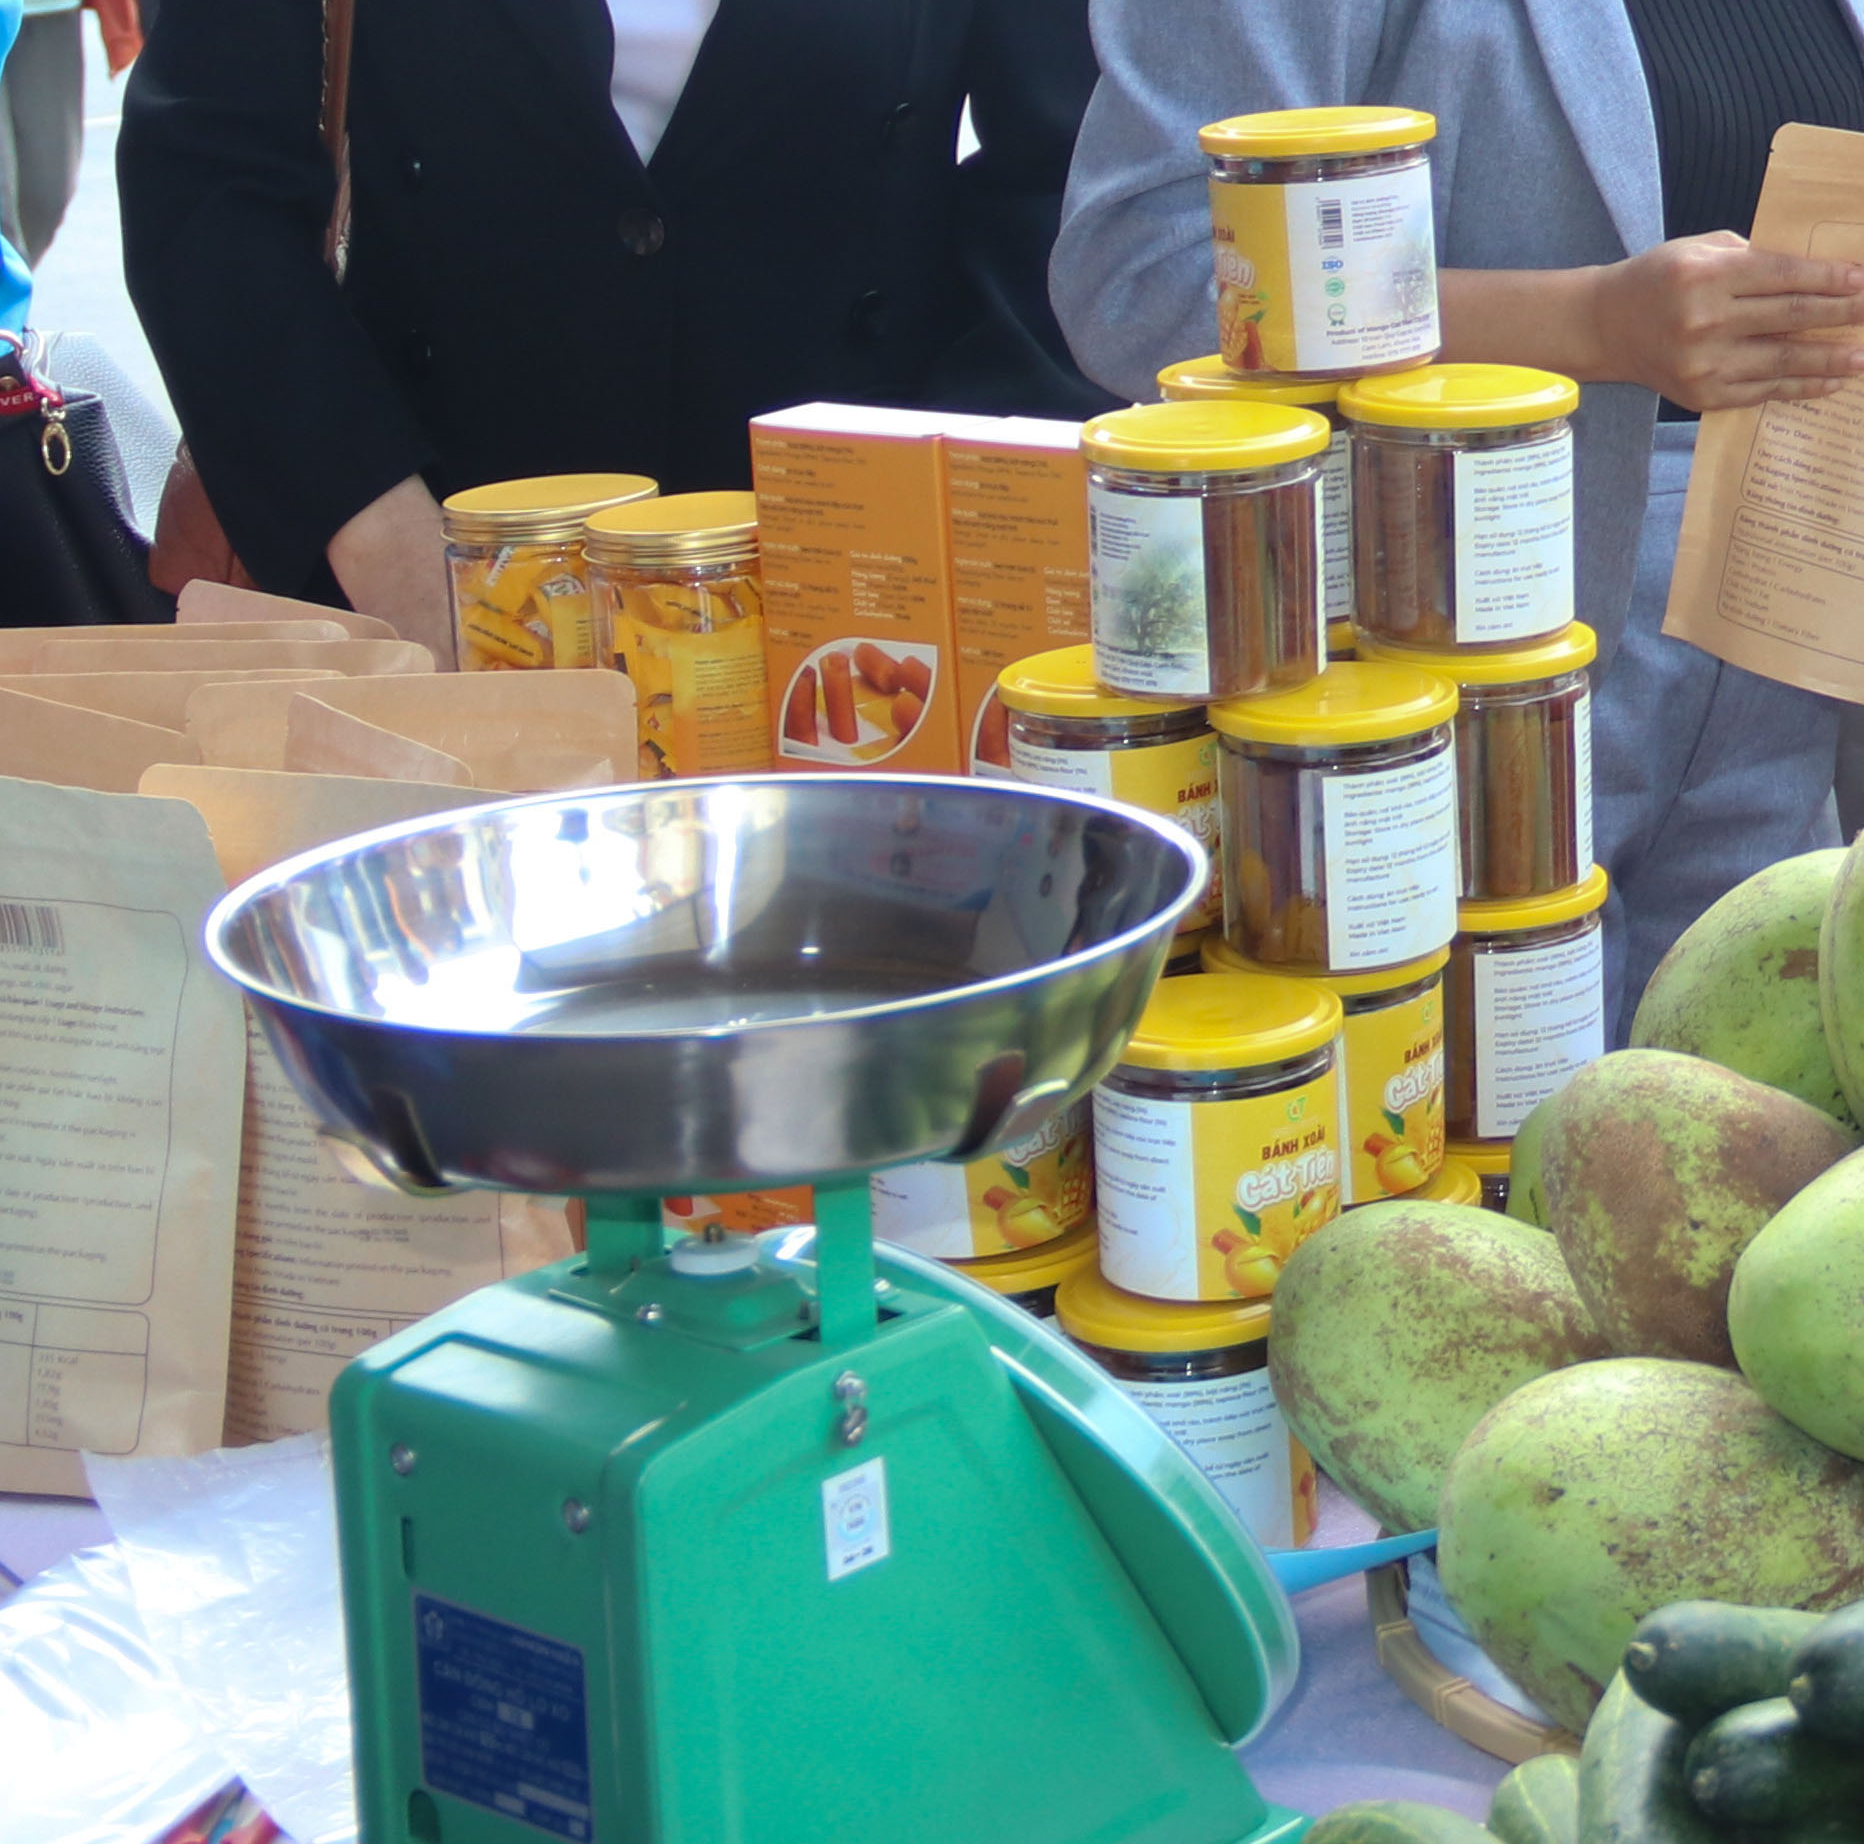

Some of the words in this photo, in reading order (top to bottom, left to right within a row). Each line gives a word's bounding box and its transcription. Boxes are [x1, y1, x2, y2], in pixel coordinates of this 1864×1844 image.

[1177, 781, 1212, 804] BÁNH
[1404, 1041, 1431, 1064] BÁNH
[1262, 1137, 1299, 1161] BÁNH
[1303, 1124, 1326, 1149] XOÀI
[1237, 1162, 1298, 1211] Cát
